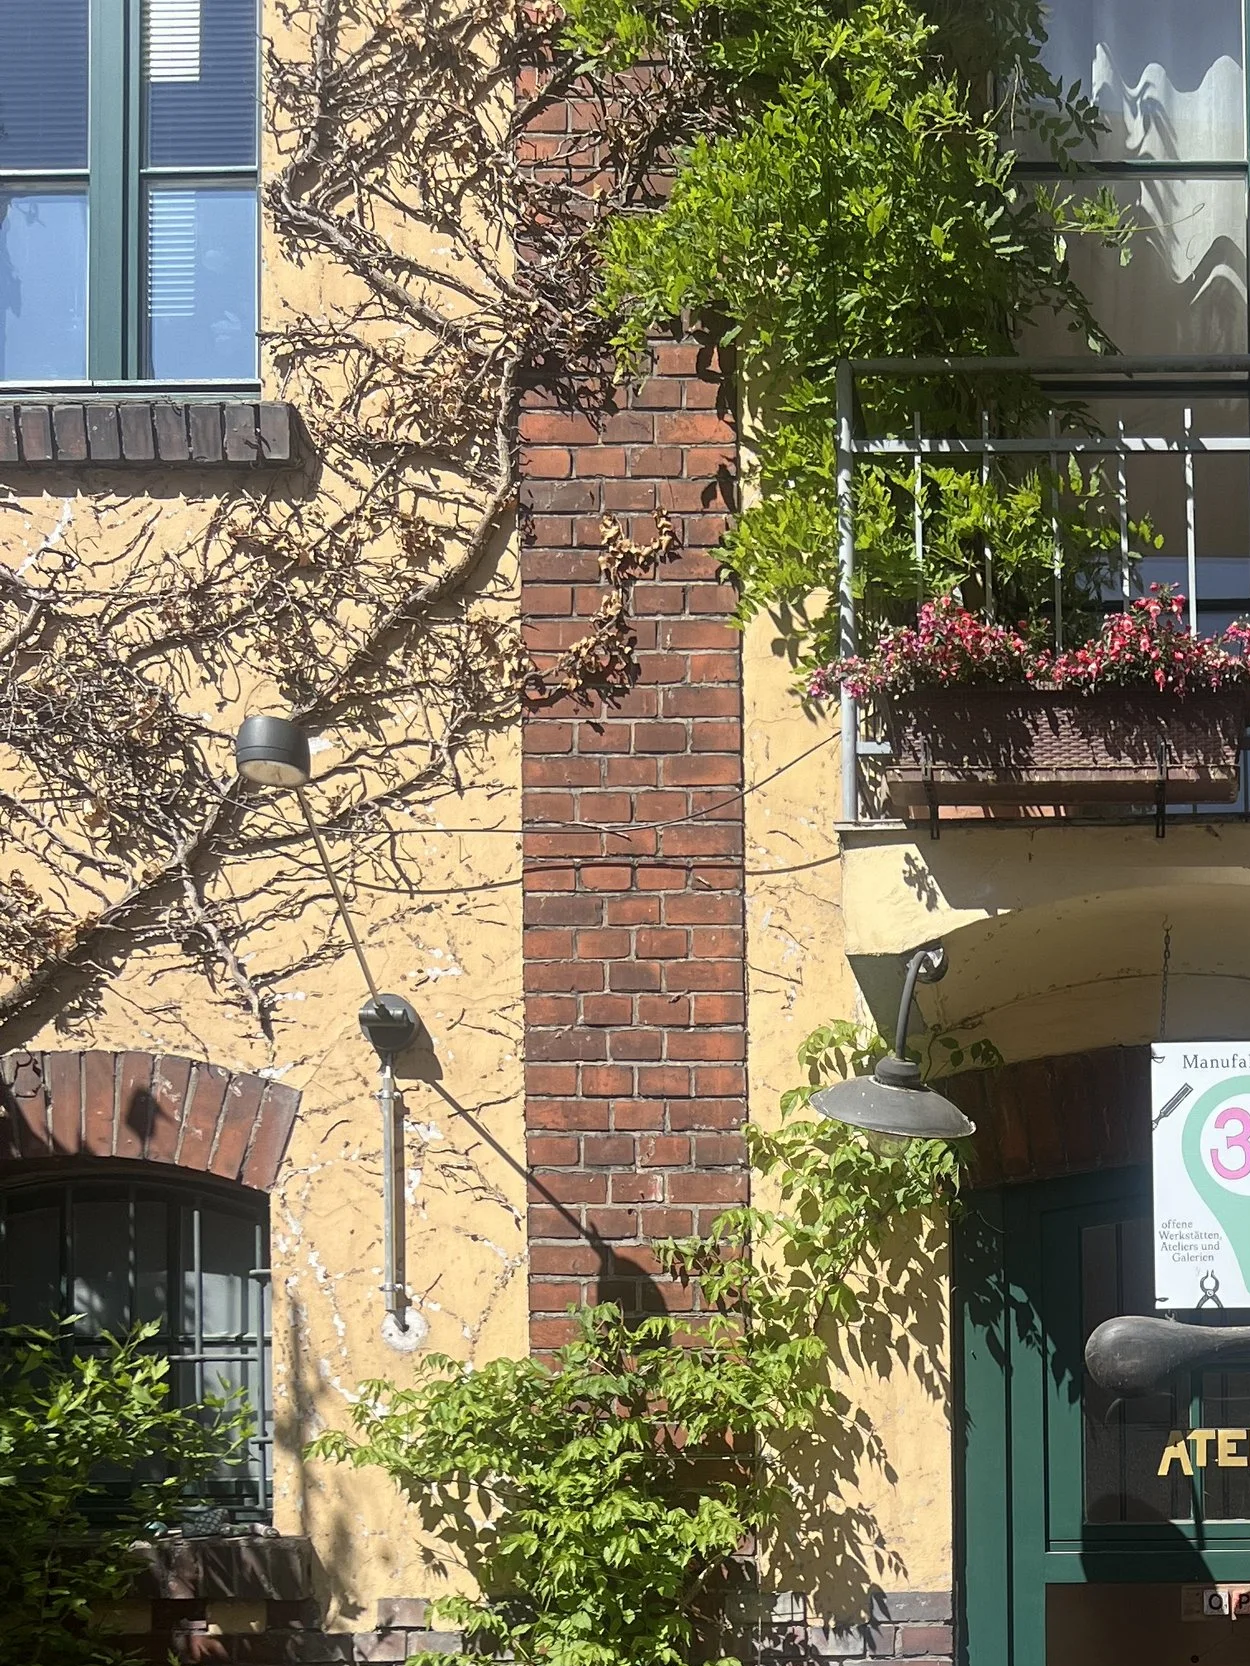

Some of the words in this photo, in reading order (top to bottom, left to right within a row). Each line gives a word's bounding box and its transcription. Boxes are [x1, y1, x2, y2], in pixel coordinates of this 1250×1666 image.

[1161, 1219, 1193, 1229] offene
[1158, 1231, 1222, 1242] Werkstätten,
[1160, 1242, 1199, 1251] Ateliers
[1201, 1241, 1220, 1251] und
[1172, 1252, 1215, 1262] Galerien
